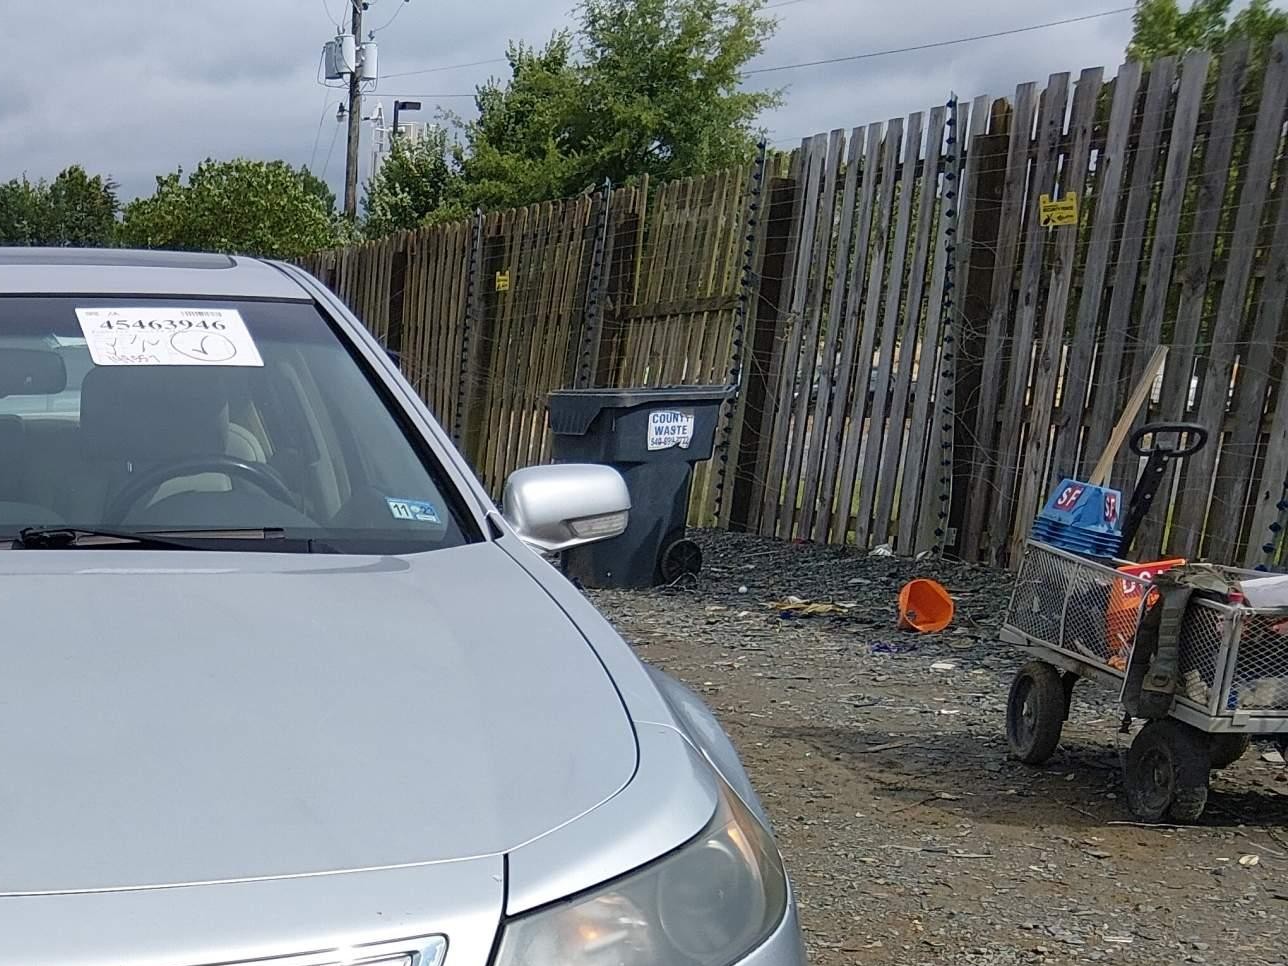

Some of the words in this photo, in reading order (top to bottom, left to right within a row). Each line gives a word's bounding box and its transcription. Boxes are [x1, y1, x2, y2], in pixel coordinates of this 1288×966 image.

[99, 319, 226, 331] 45463946
[654, 425, 688, 436] WASTE
[1057, 487, 1084, 507] SF
[393, 503, 410, 517] 11
